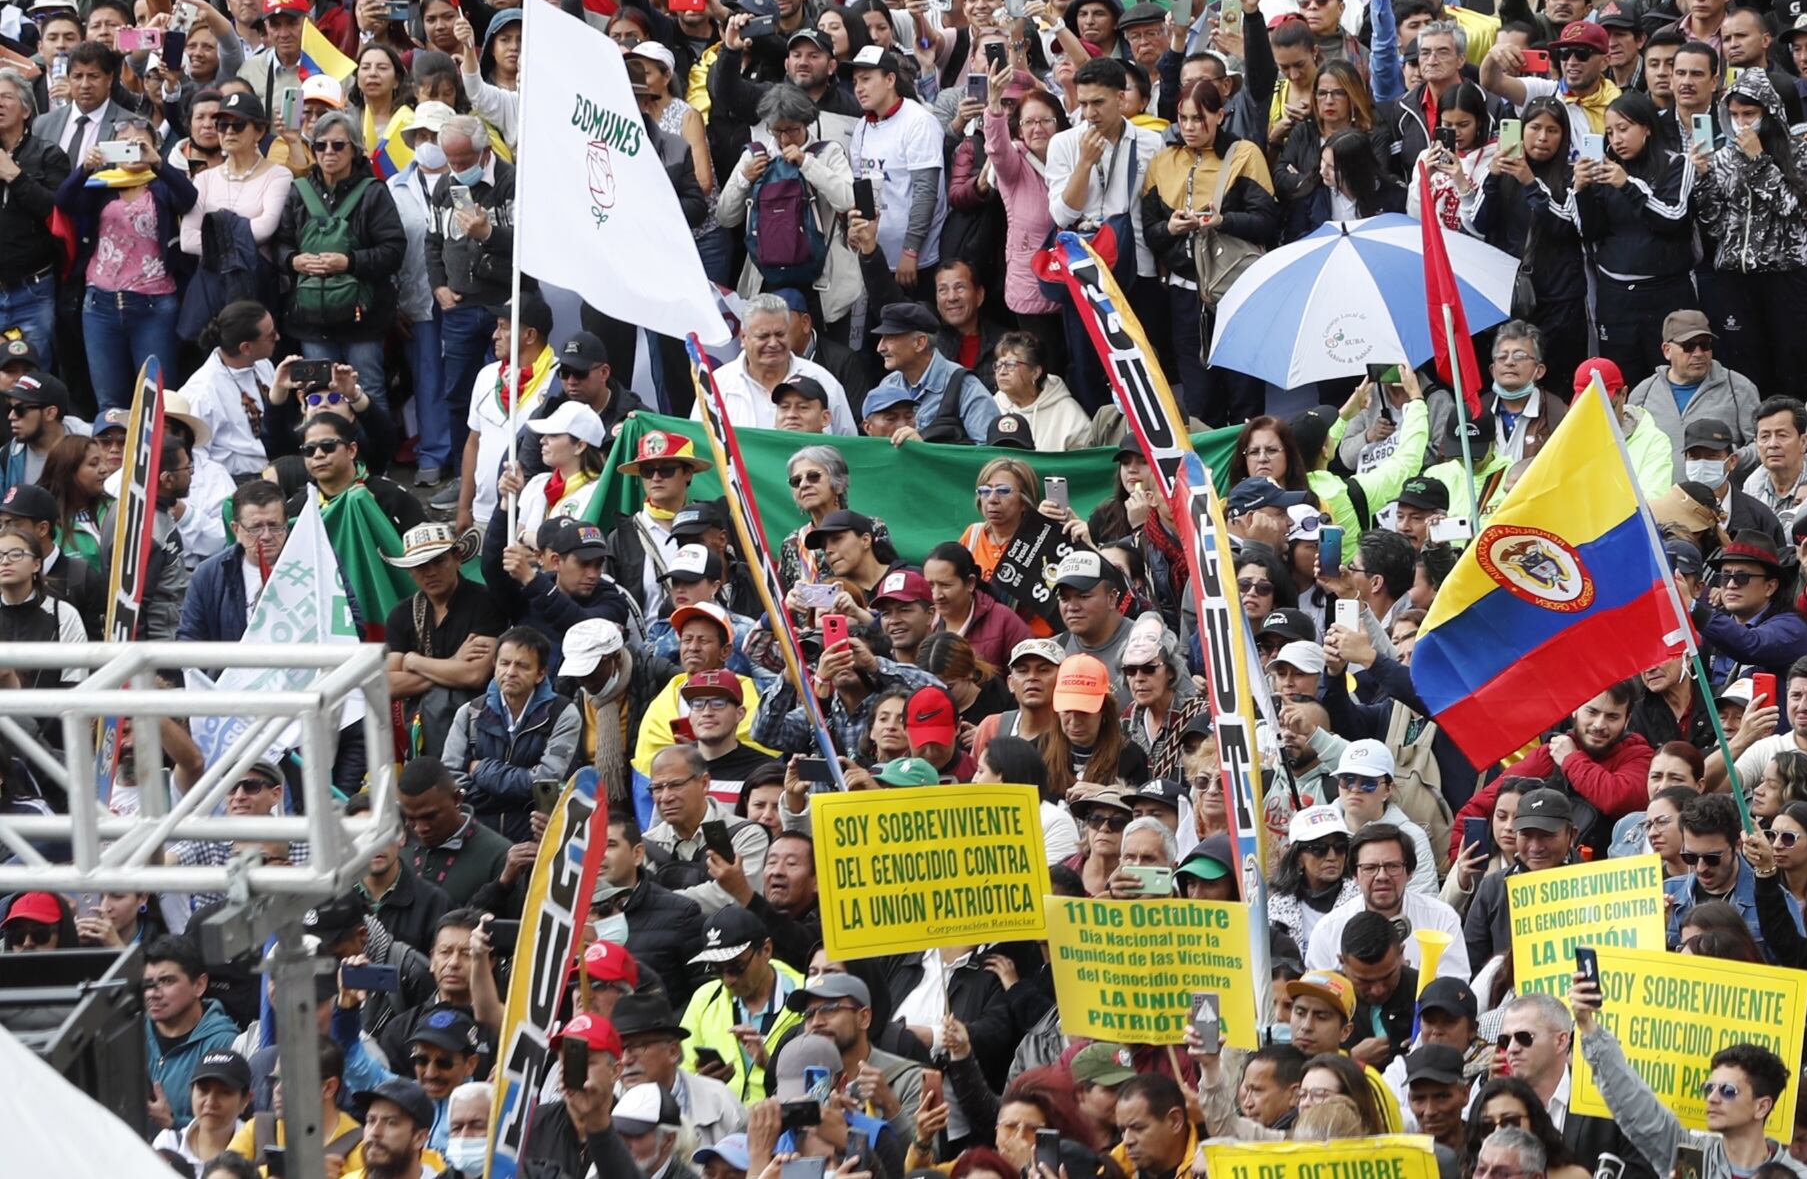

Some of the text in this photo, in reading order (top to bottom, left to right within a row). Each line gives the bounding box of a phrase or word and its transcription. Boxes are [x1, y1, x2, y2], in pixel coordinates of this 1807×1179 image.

[571, 93, 644, 156] COMUNES
[834, 806, 1024, 848] SOY SOBREVIVIENTE
[835, 844, 1031, 890] DEL GENOCIDIO CONTRA
[839, 879, 1035, 931] LA UNIÓN PATRIÓTICA
[1511, 866, 1658, 910] SOY SOBREVIVIENTE
[926, 917, 1036, 936] Corporación Reiniciar
[1064, 900, 1230, 929] 11 De Octubre
[1514, 897, 1658, 937] DEL GENOCIDIO CONTRA
[1106, 931, 1173, 948] Nacional
[1177, 932, 1203, 948] por
[1206, 933, 1220, 948] la
[1531, 940, 1558, 967] LA
[1059, 945, 1243, 970] Dignidad de las Víctimas
[1077, 967, 1231, 989] del Genocidio contra
[1100, 989, 1193, 1010] LA UNIÓ
[1601, 970, 1636, 1006] SOY
[1642, 974, 1786, 1026] SOBREVIVIENTE
[1629, 1015, 1713, 1057] GENOCIDIO
[1231, 1157, 1405, 1179] 11 DE OCTUBRE
